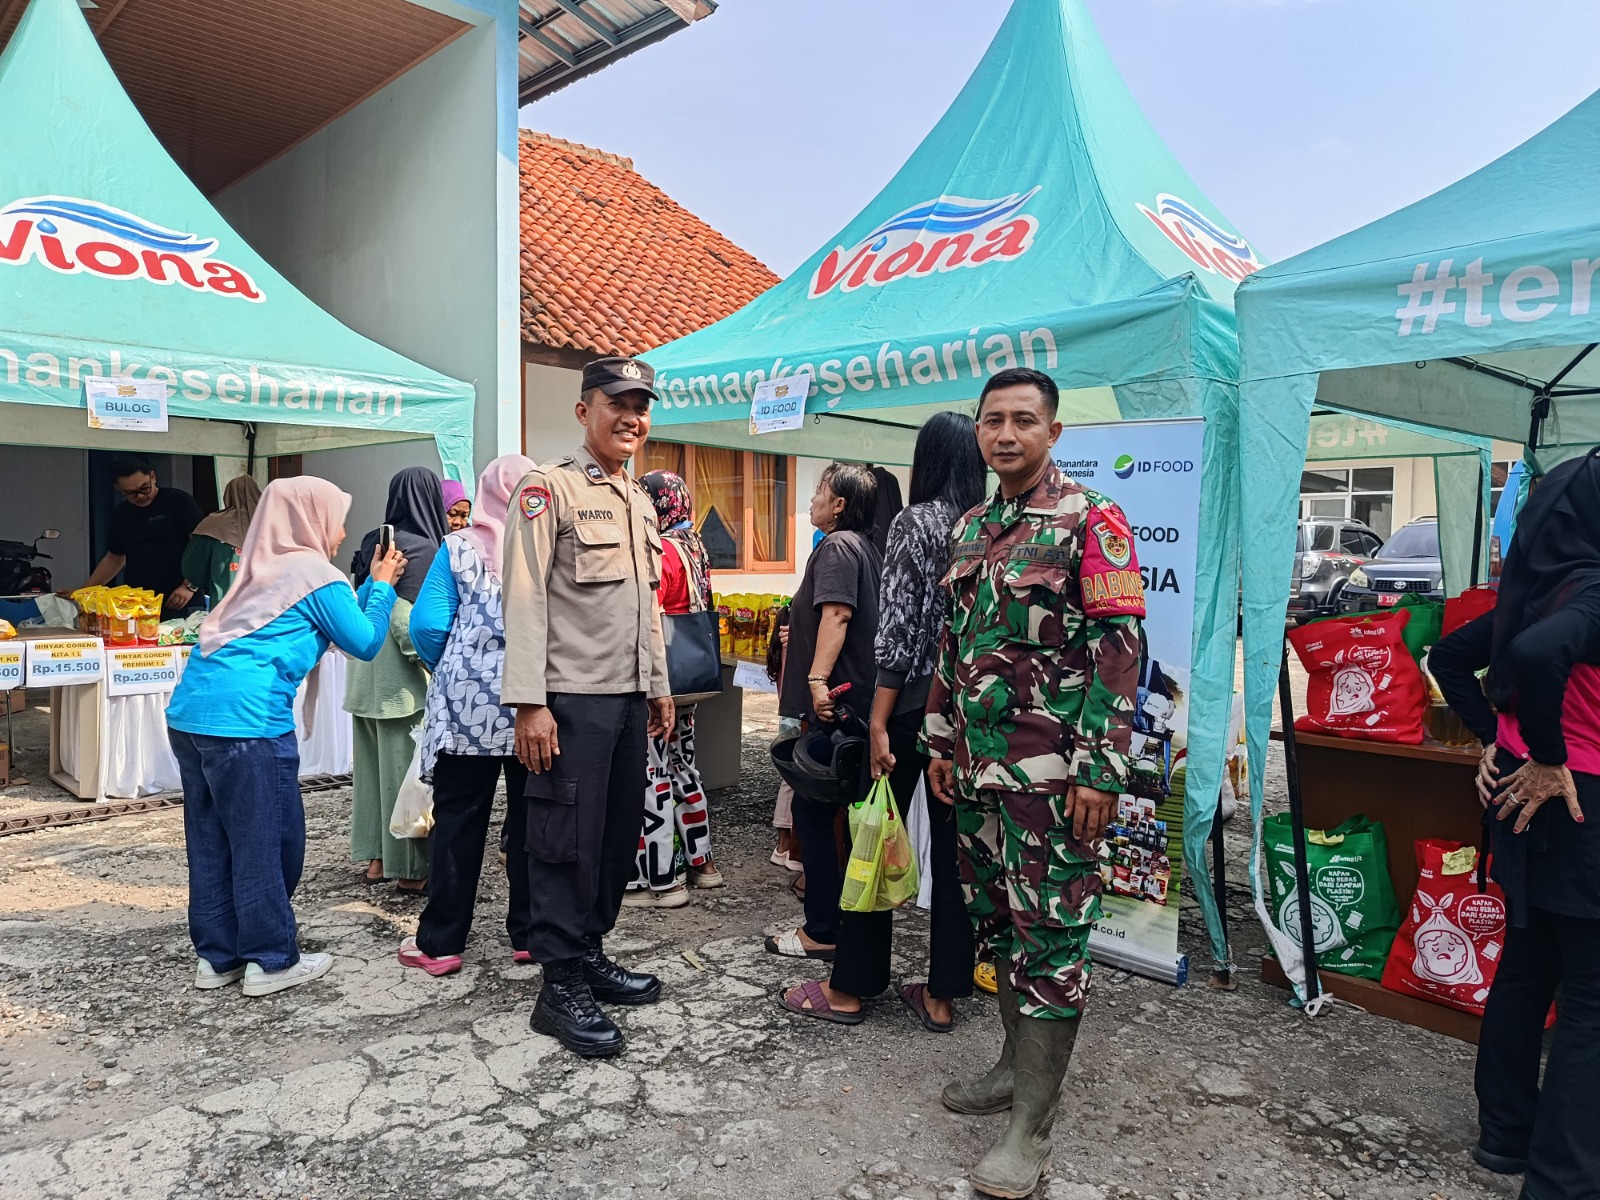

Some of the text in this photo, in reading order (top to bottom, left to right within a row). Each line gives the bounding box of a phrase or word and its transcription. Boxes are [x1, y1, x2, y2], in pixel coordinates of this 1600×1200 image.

[813, 218, 1030, 295] Viona
[105, 401, 151, 413] BULOG
[760, 401, 797, 415] ID FOOD
[1056, 459, 1098, 468] Danantara
[1137, 460, 1194, 472] ID FOOD
[577, 509, 614, 520] WARYO
[1131, 525, 1180, 543] FOOD
[1015, 546, 1039, 558] TNI
[6, 655, 19, 663] KG
[0, 667, 19, 678] 00
[32, 661, 100, 675] Rp.15.500
[113, 671, 175, 684] Rp.20.500
[1091, 922, 1126, 939] d.co.id
